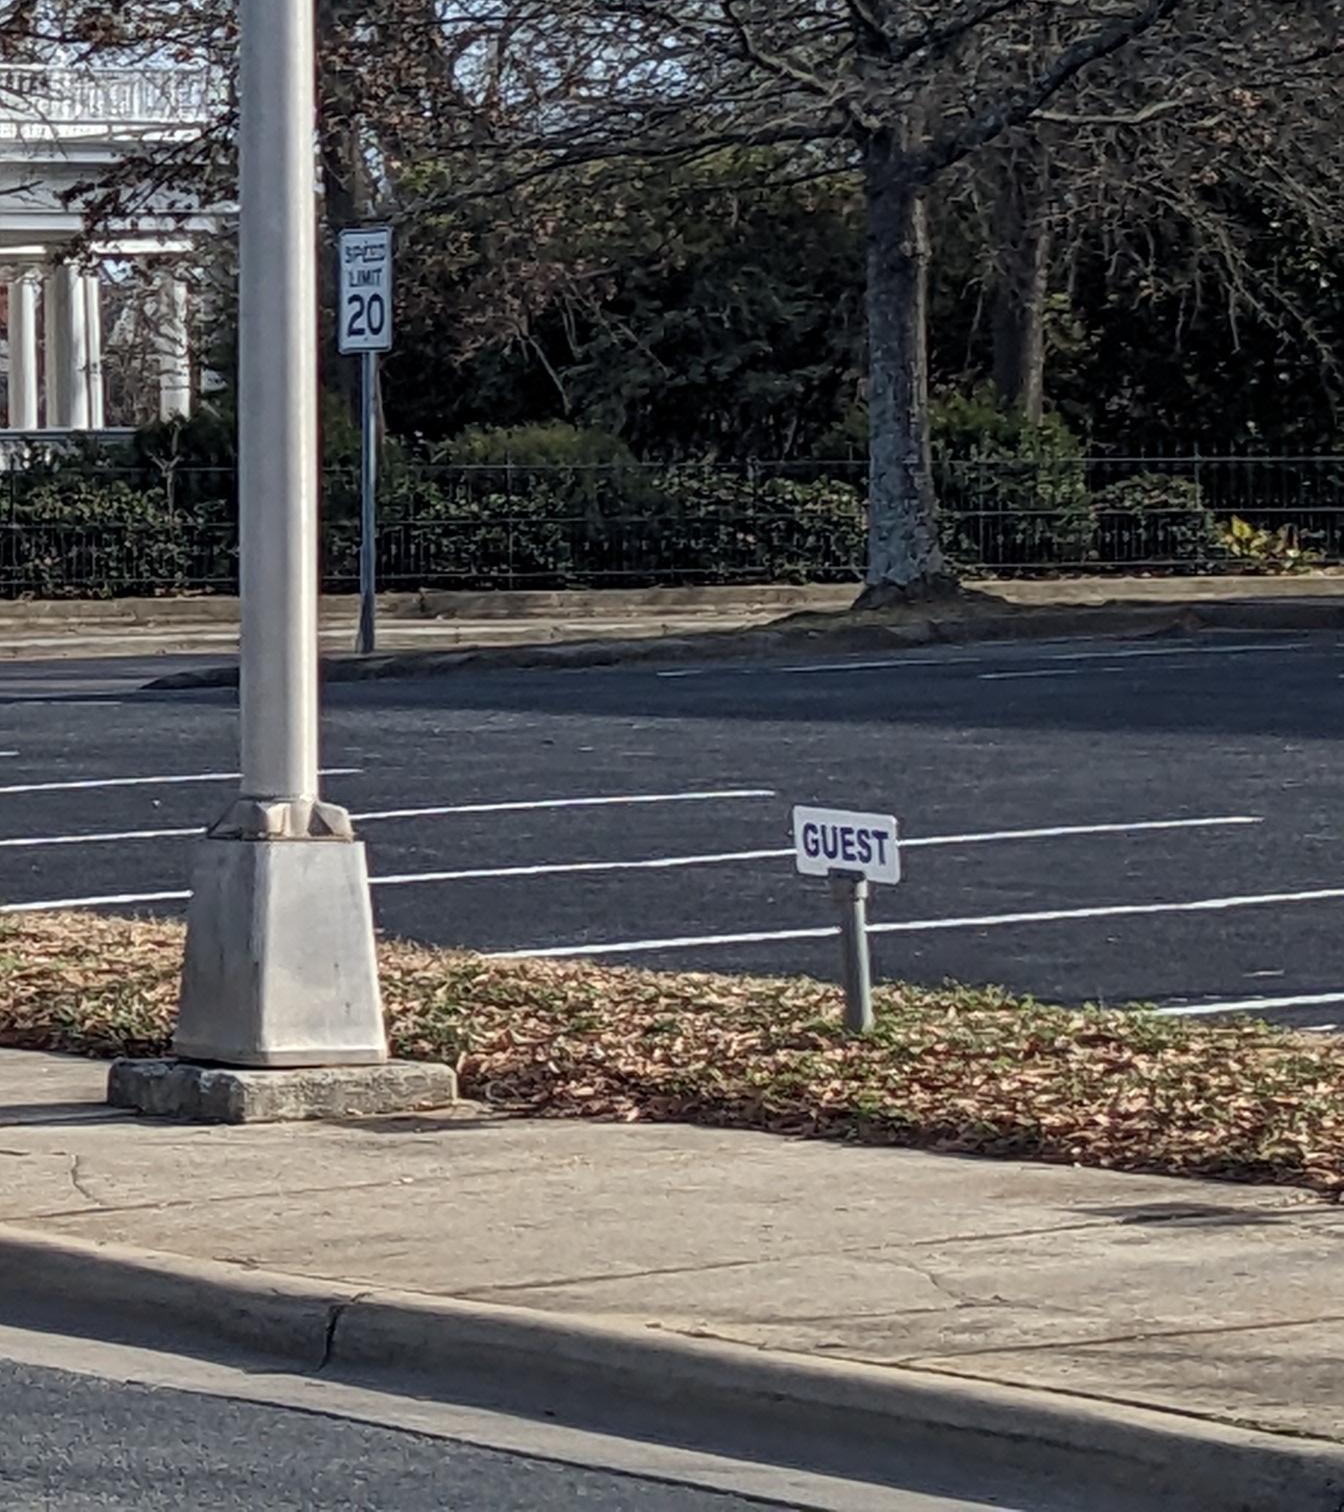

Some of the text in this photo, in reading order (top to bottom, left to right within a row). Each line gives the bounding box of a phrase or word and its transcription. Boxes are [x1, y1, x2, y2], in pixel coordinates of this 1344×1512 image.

[349, 268, 382, 287] LIMIT
[347, 293, 385, 337] 20
[803, 822, 889, 866] GUEST
